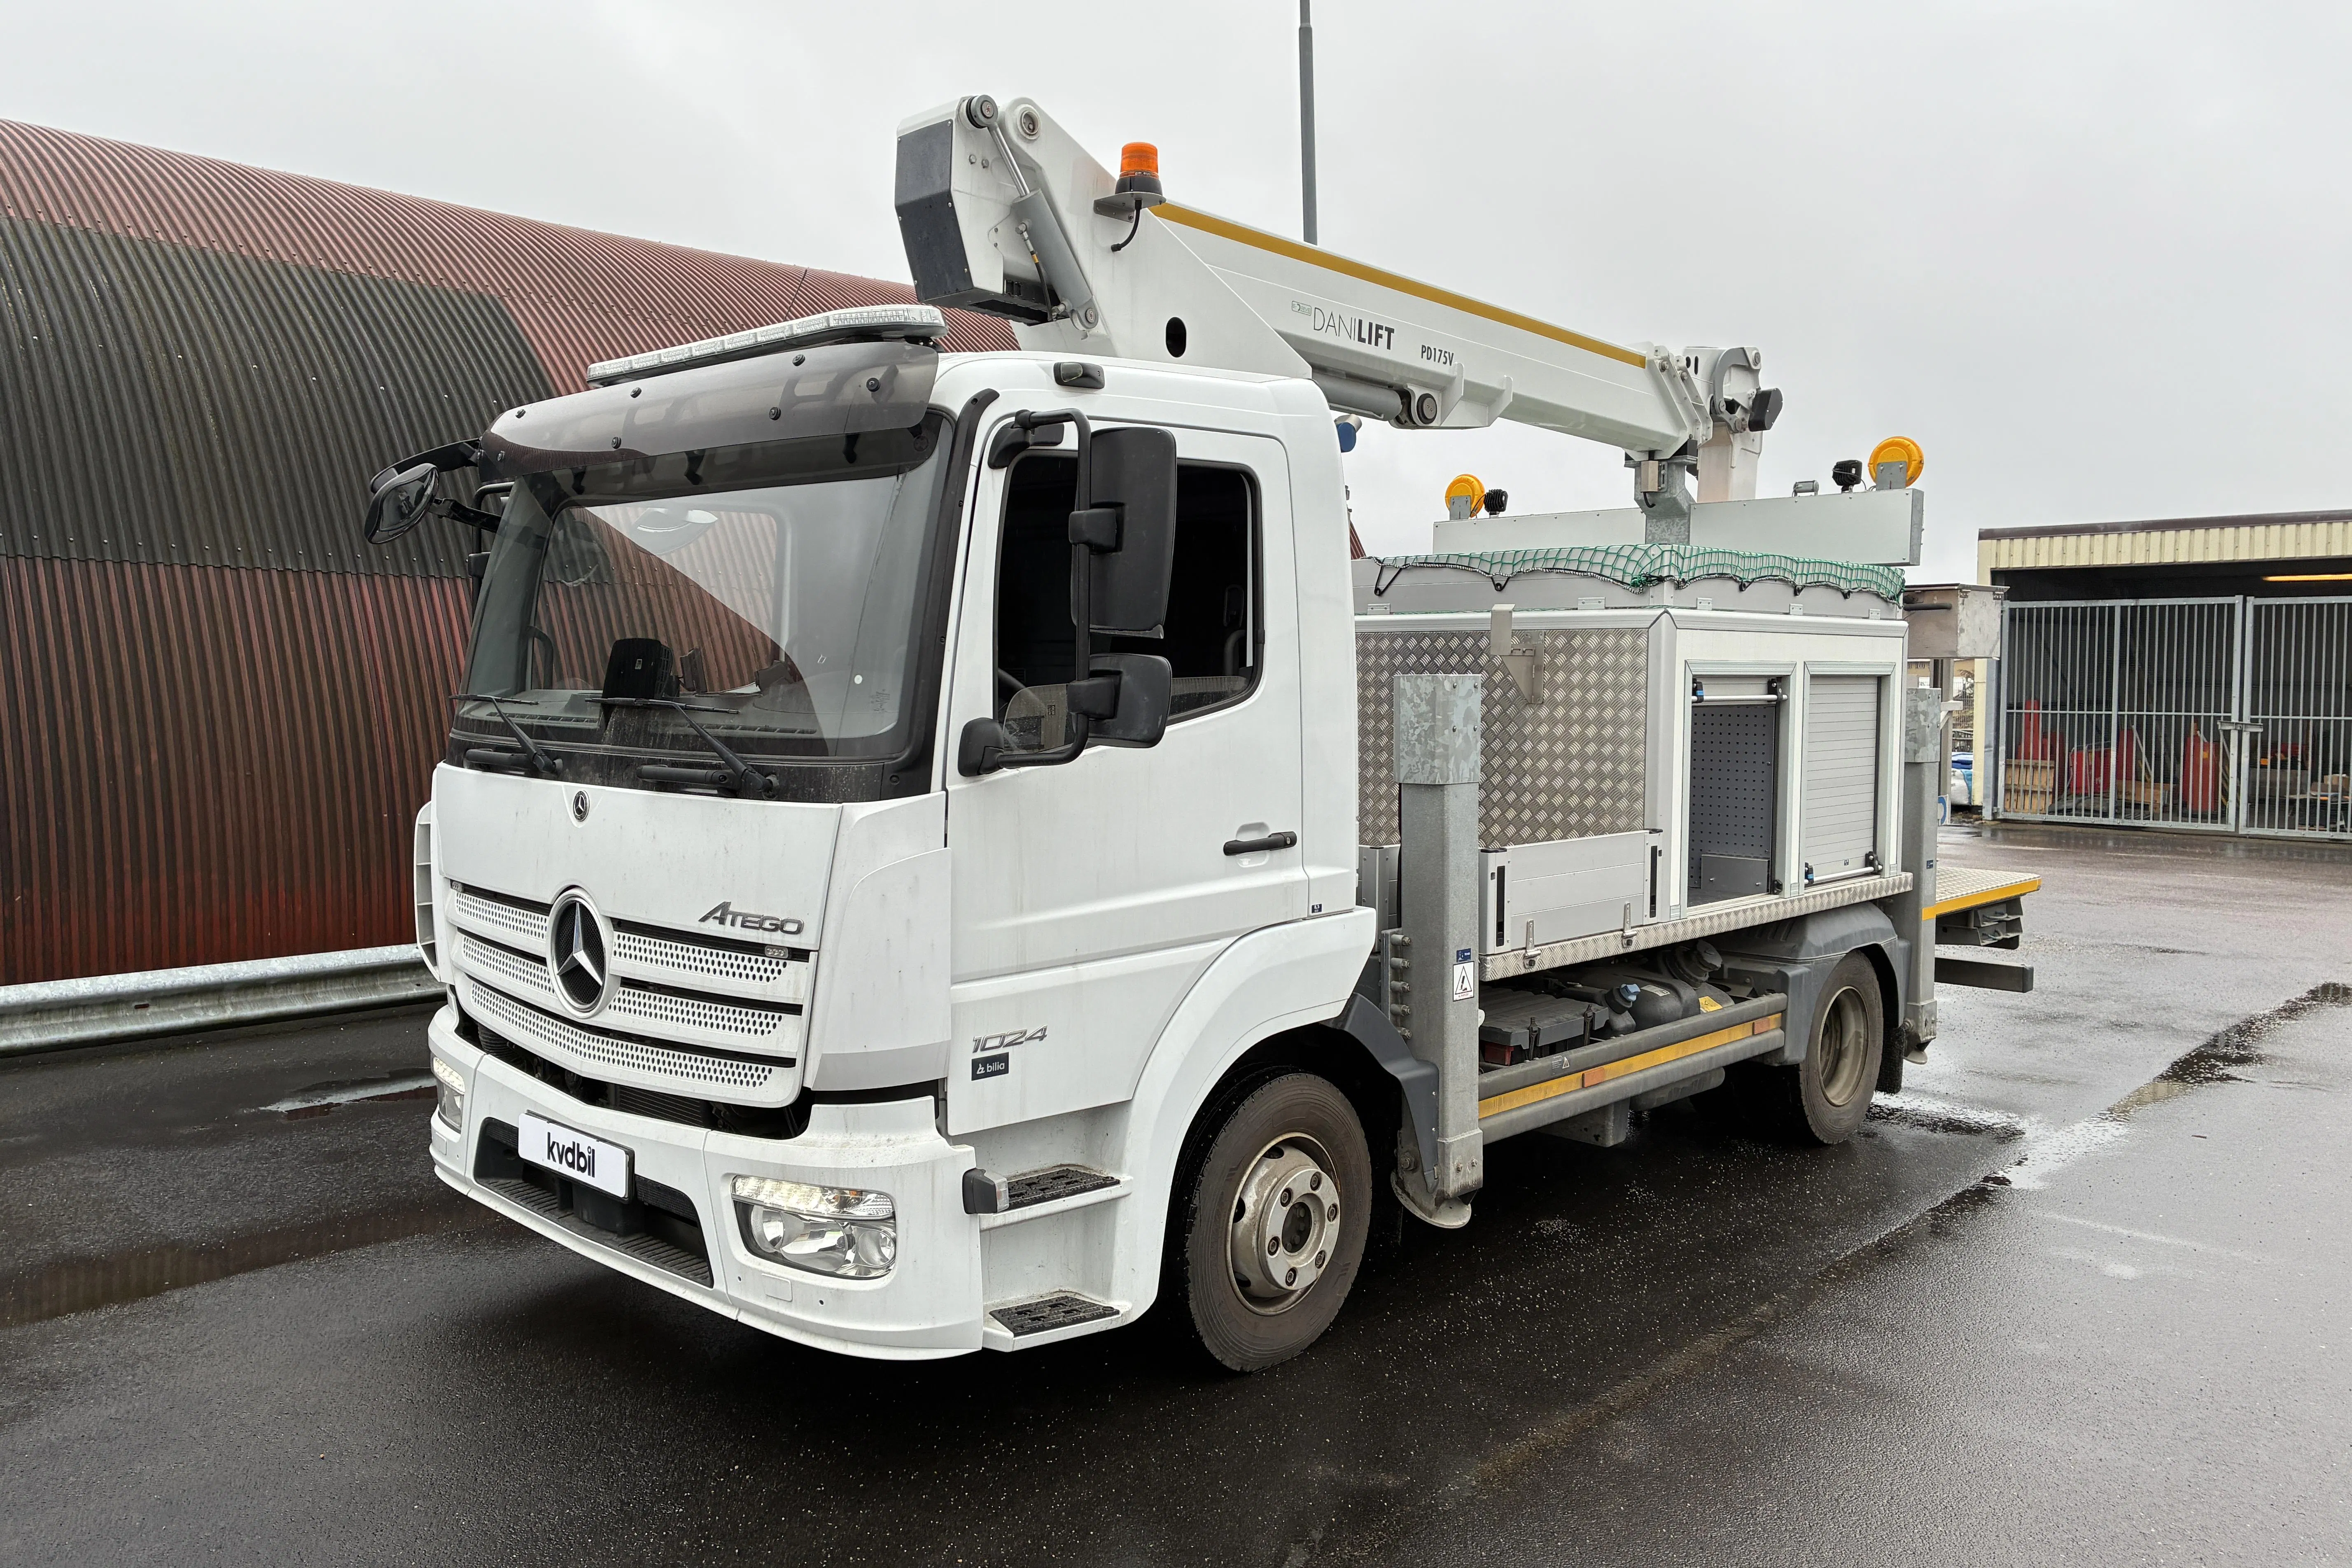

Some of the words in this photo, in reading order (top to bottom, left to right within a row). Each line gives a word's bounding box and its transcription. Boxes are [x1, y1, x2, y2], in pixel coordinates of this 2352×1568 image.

[1314, 307, 1395, 350] DANILIFT
[1421, 344, 1454, 366] PD175V
[972, 1024, 1048, 1053] 1024
[987, 1062, 1005, 1072] bilia
[547, 1132, 595, 1178] kvdbil
